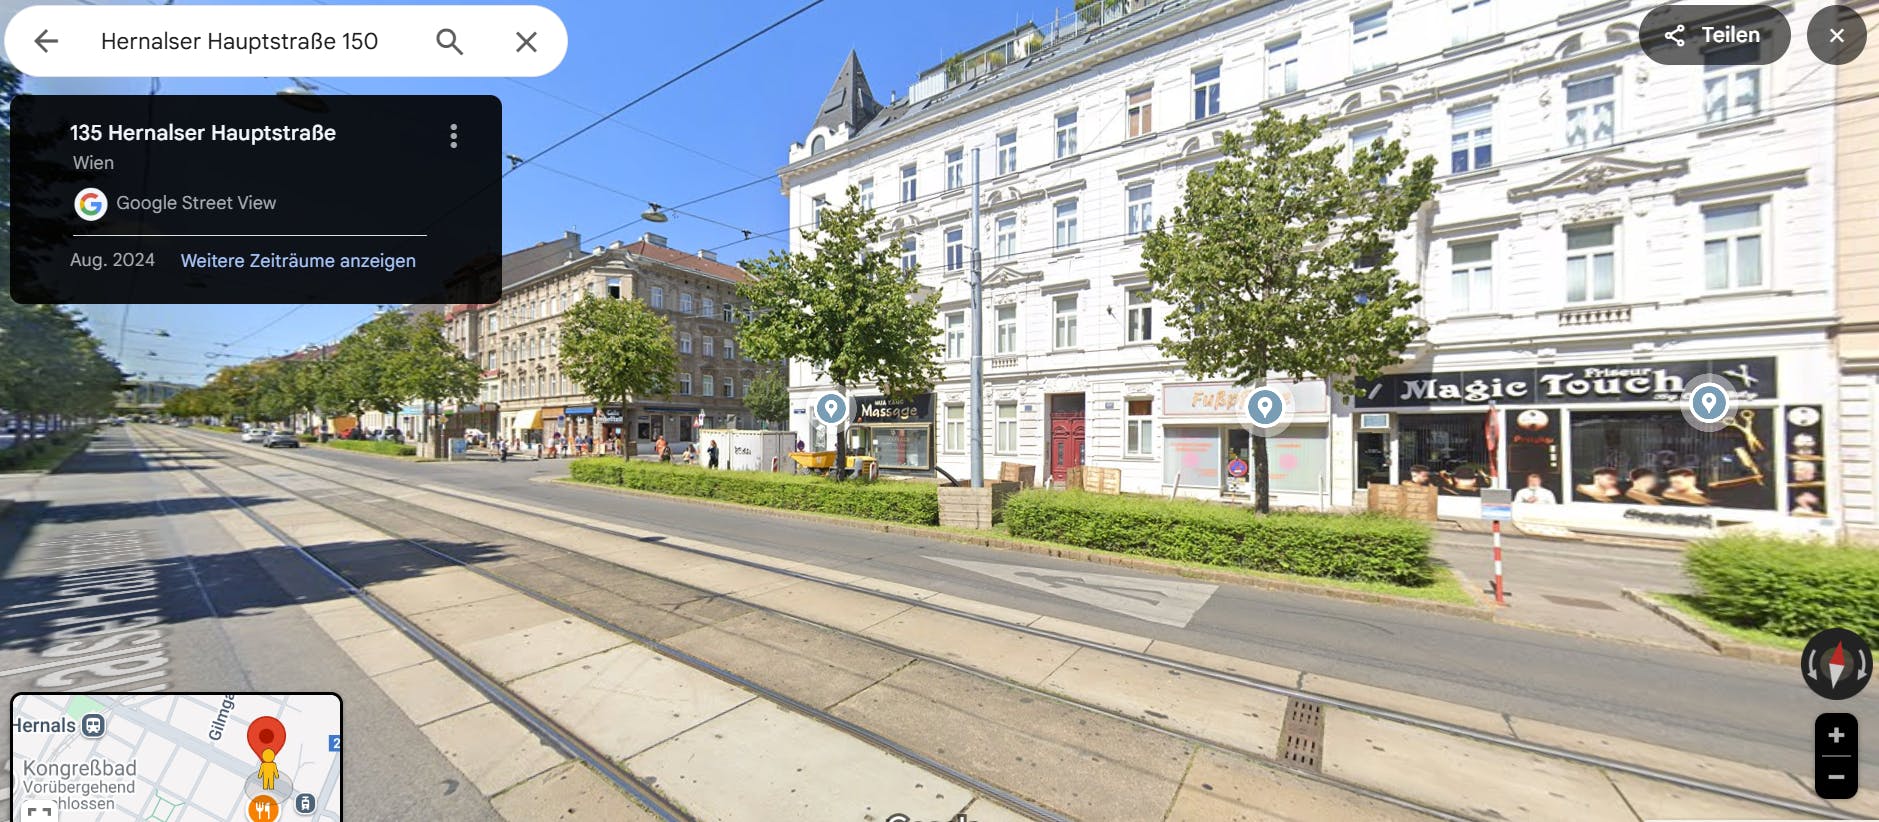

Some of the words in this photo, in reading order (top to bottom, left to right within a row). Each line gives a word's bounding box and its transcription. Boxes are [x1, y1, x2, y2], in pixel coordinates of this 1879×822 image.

[1584, 367, 1652, 379] Friseur
[1401, 377, 1529, 402] Magic
[1540, 368, 1686, 397] Touch
[861, 403, 918, 420] Massage
